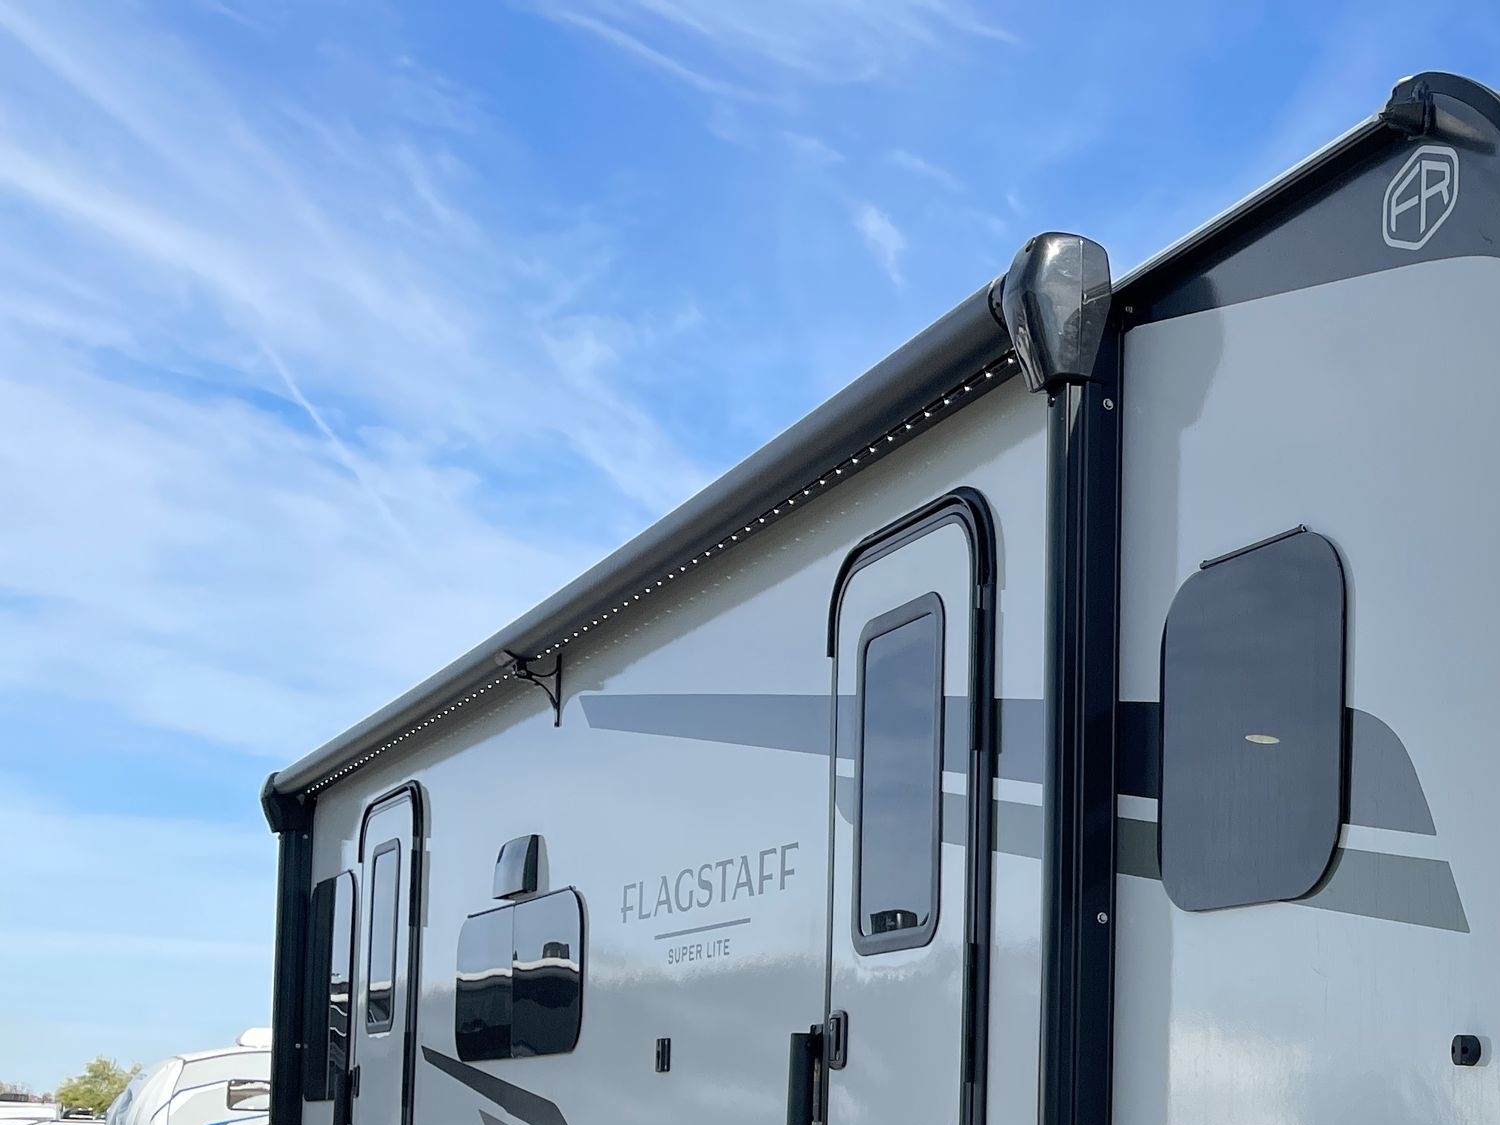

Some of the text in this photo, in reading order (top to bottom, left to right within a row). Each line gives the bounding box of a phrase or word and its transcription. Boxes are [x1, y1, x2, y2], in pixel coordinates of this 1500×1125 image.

[620, 841, 799, 924] FLAGSTAFF
[667, 938, 731, 965] SUPER LITE
